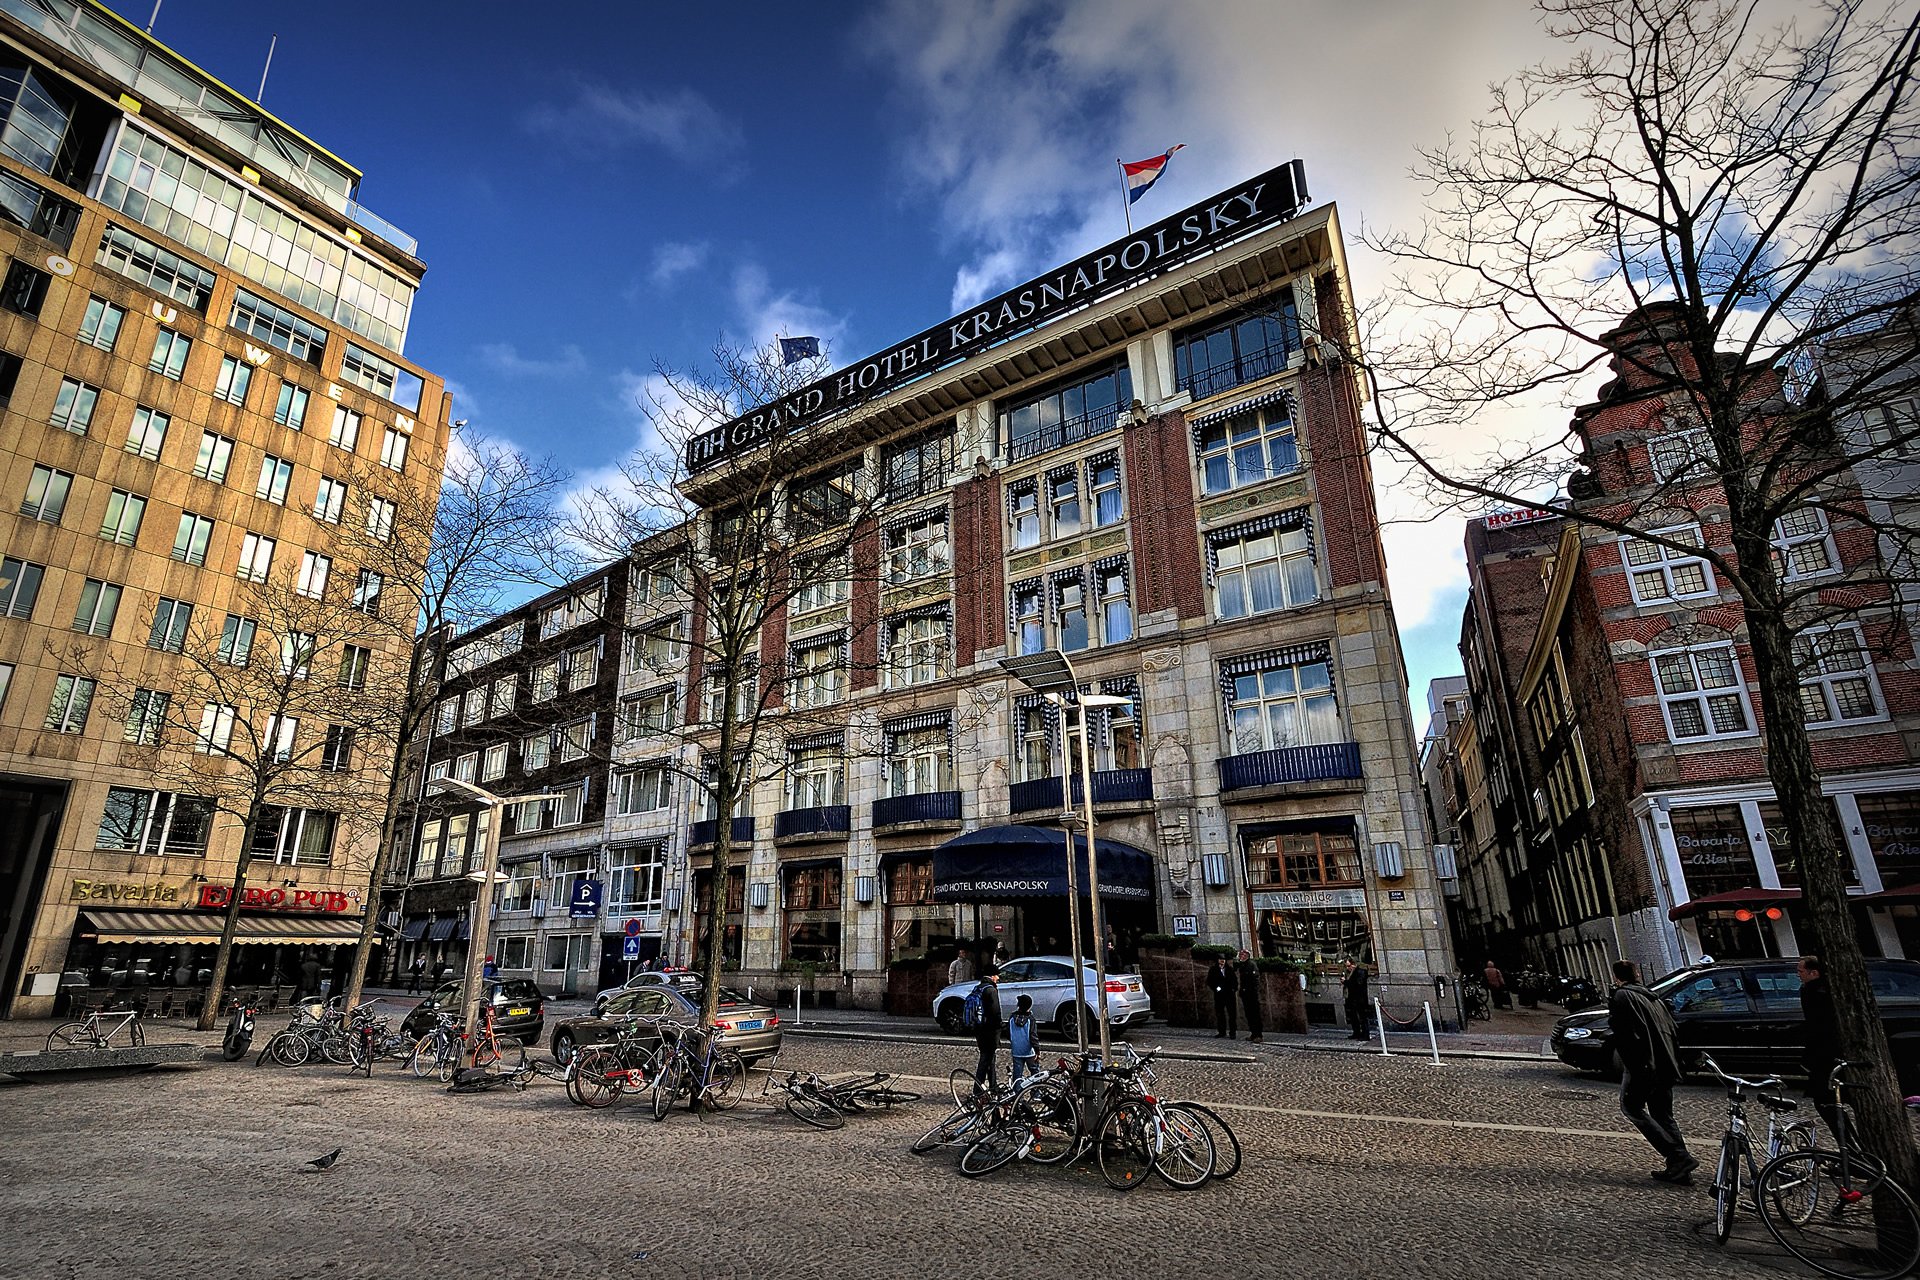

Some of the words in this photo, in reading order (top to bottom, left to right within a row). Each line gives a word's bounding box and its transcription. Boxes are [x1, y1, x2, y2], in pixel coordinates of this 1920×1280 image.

[731, 389, 824, 446] GRAND
[835, 336, 940, 400] HOTEL
[949, 183, 1266, 351] KRASNAPOLSKY
[1676, 834, 1744, 848] Bavaria
[69, 878, 178, 902] Bavaria
[949, 882, 973, 893] HOTEL
[975, 880, 1049, 891] KRASNAPOLSKY
[292, 889, 349, 912] PUB
[581, 889, 591, 900] P
[1282, 891, 1334, 903] Mathilde
